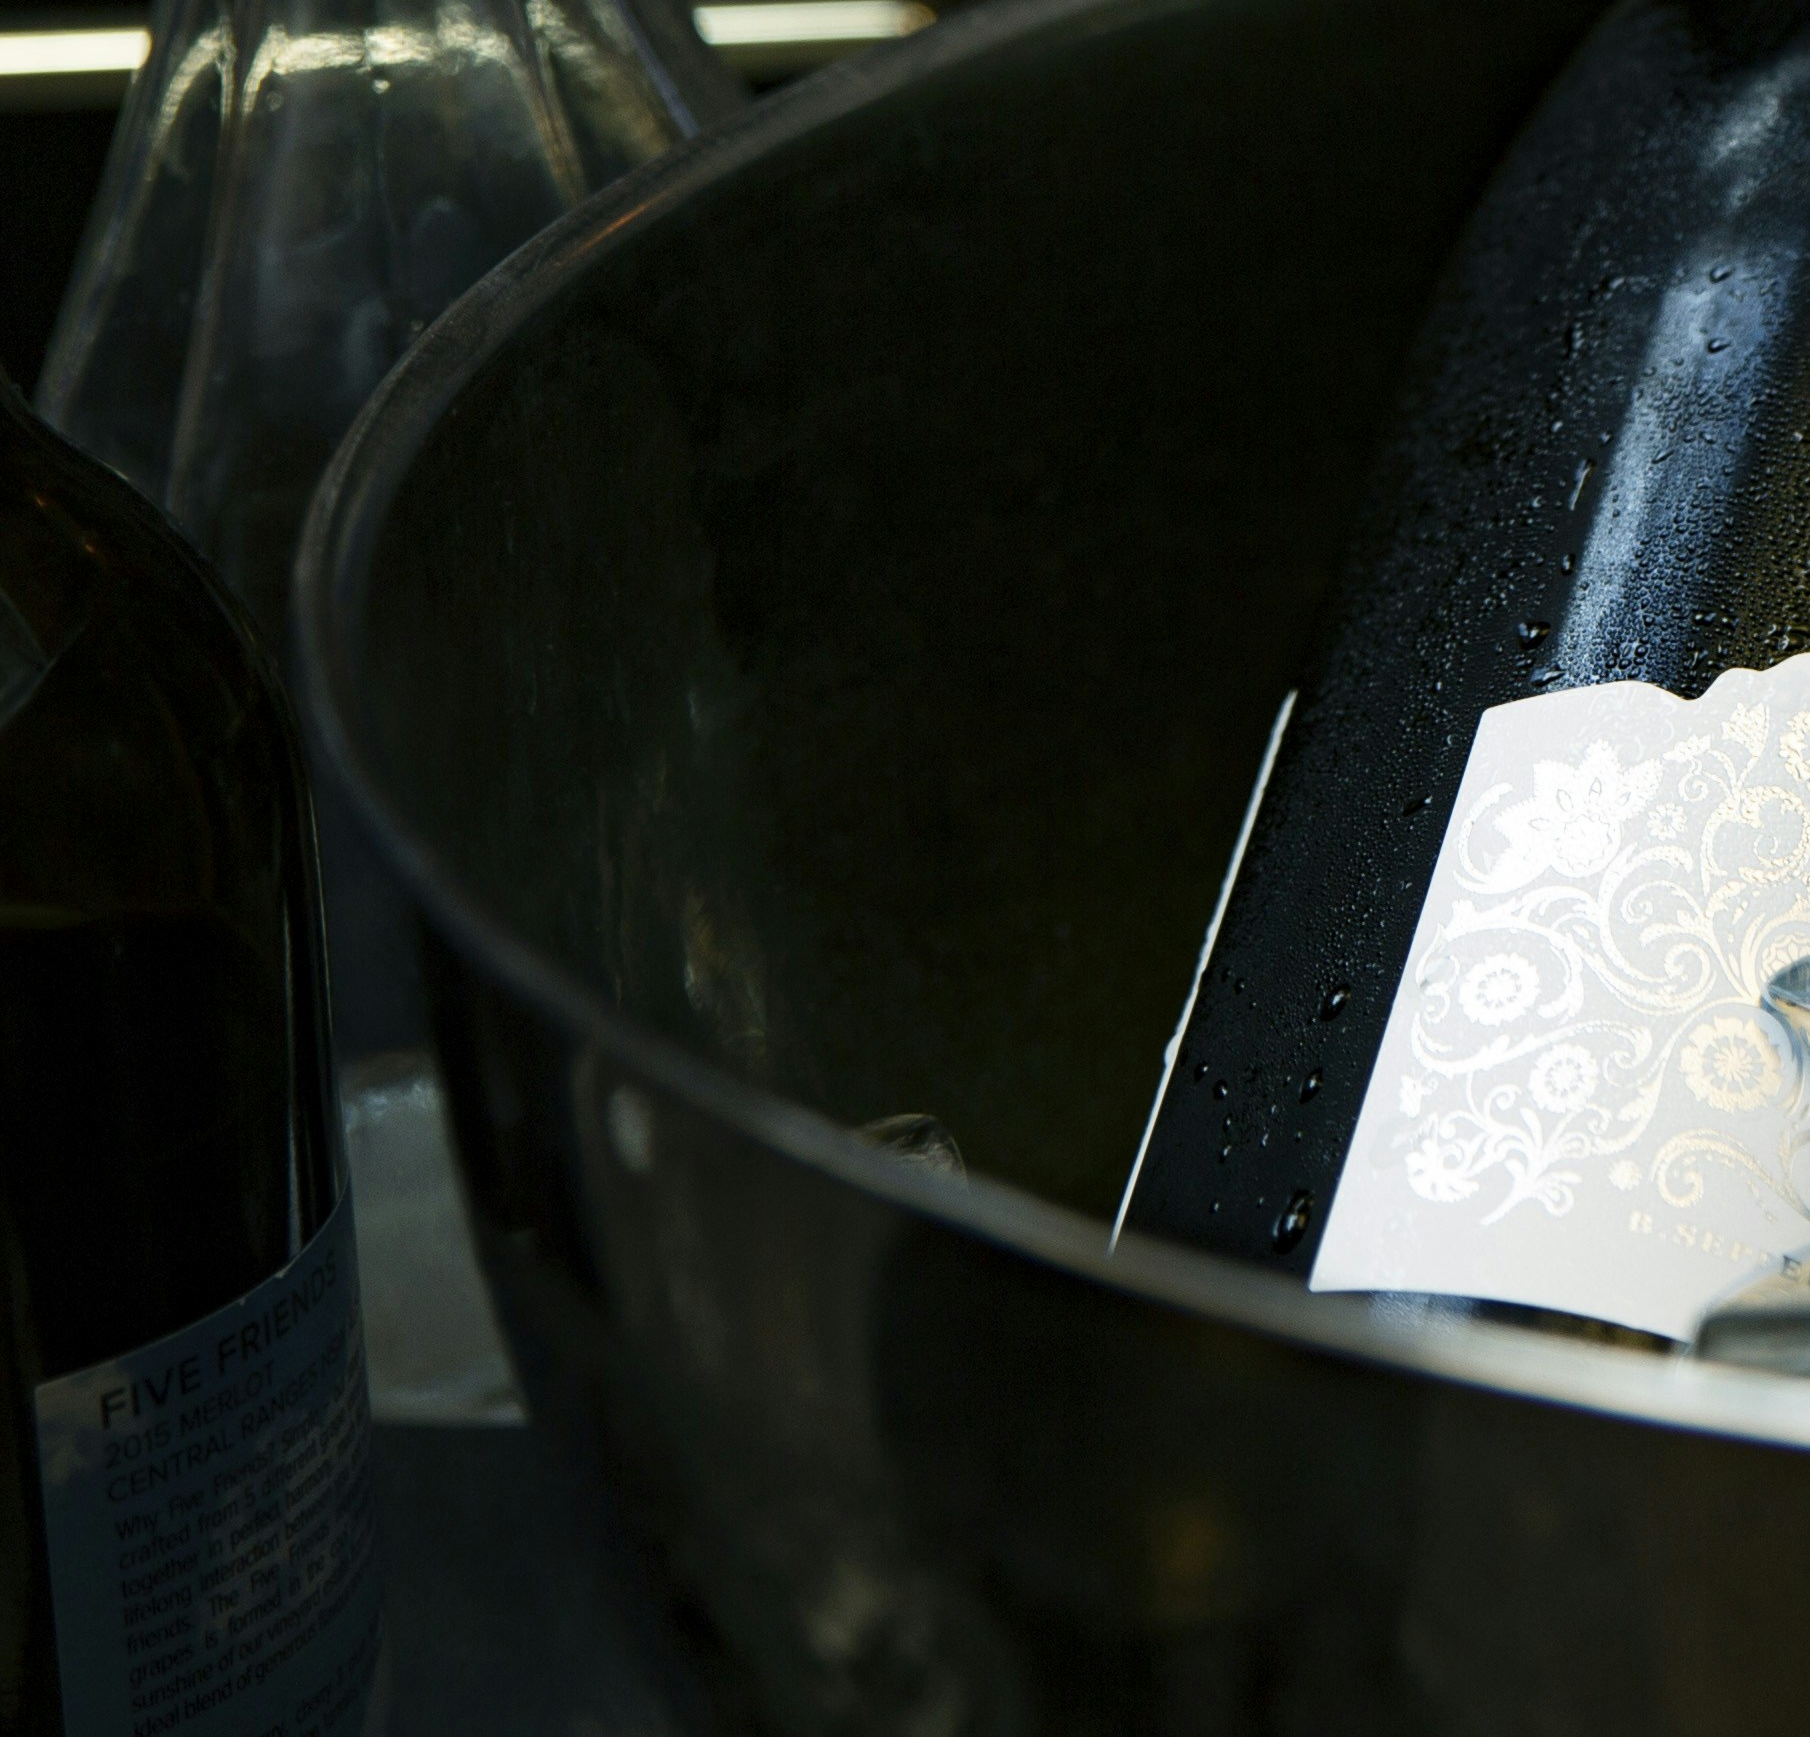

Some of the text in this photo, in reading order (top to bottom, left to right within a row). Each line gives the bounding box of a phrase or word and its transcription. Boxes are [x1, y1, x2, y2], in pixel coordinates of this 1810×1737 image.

[100, 1355, 202, 1429] FIVE
[216, 1249, 337, 1376] FRIENDS
[103, 1421, 171, 1470] 2015
[179, 1359, 275, 1437] MERLOT
[106, 1428, 236, 1503] CENTRAL
[240, 1362, 318, 1440] RANGES
[118, 1521, 191, 1570] crafted
[197, 1501, 239, 1534] from
[244, 1484, 256, 1508] 5
[120, 1550, 200, 1599] together
[207, 1537, 224, 1559] in
[229, 1500, 280, 1553] perfect
[168, 1490, 205, 1521] Five
[123, 1585, 193, 1628] lifelong
[199, 1533, 280, 1593] interaction
[208, 1589, 239, 1617] The
[129, 1644, 194, 1690] grapes
[204, 1630, 219, 1651] is
[227, 1588, 282, 1636] formed
[131, 1662, 214, 1713] sunshine
[217, 1645, 236, 1673] of
[238, 1632, 264, 1660] our
[184, 1678, 233, 1720] blend
[236, 1666, 252, 1692] of
